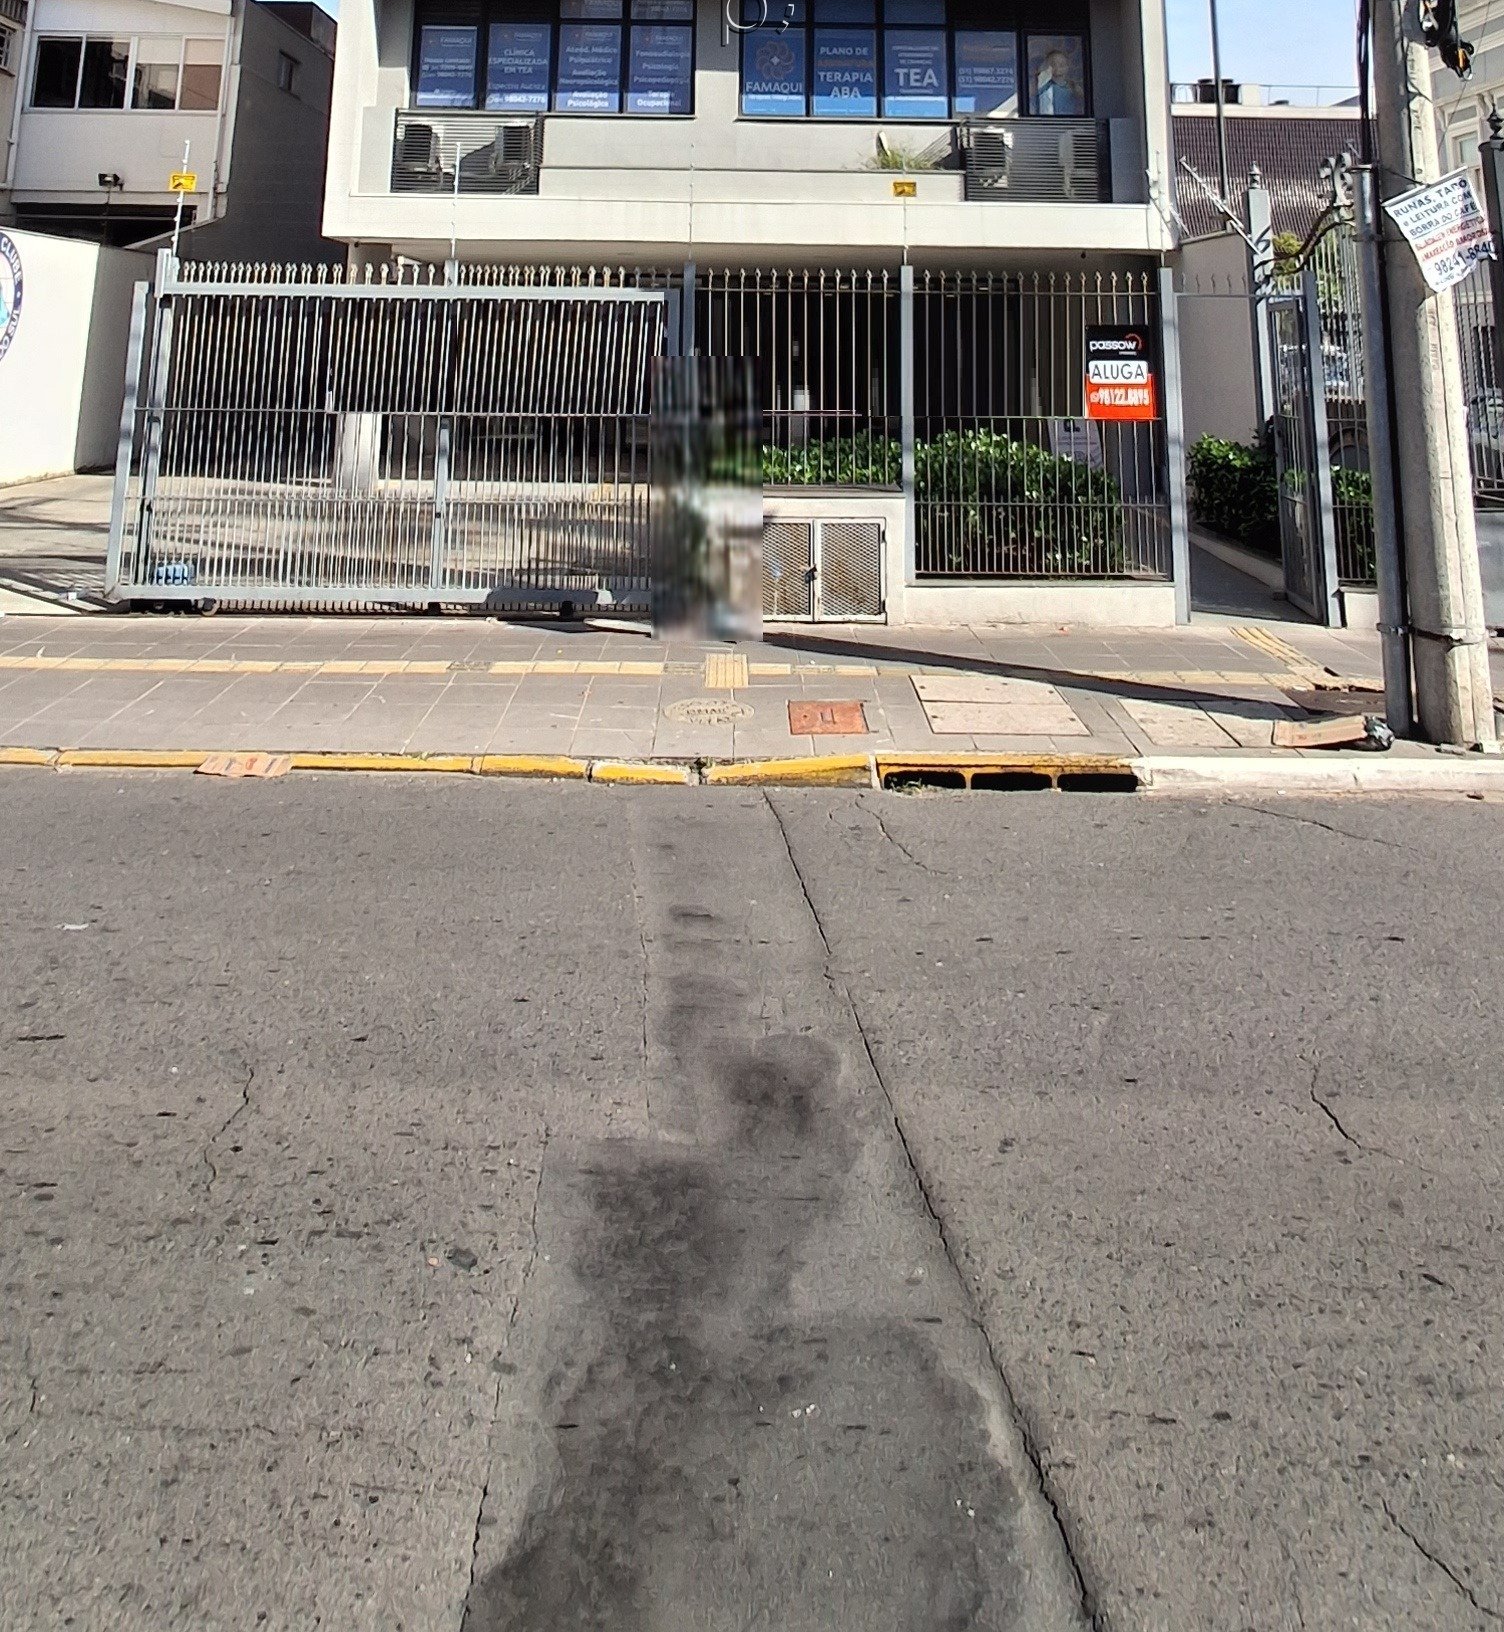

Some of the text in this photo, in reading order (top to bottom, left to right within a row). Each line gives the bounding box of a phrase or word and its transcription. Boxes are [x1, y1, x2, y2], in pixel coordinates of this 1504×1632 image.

[820, 46, 869, 56] PLANO DE
[818, 72, 874, 83] TERAPIA
[893, 68, 939, 88] TEA
[745, 81, 803, 93] FAMAQUI
[829, 86, 862, 99] ABA
[1410, 199, 1449, 223] LEITURA
[1452, 190, 1474, 205] COM
[1, 236, 22, 285] CLUBE
[1089, 340, 1137, 352] passow
[1091, 363, 1146, 380] ALUGA
